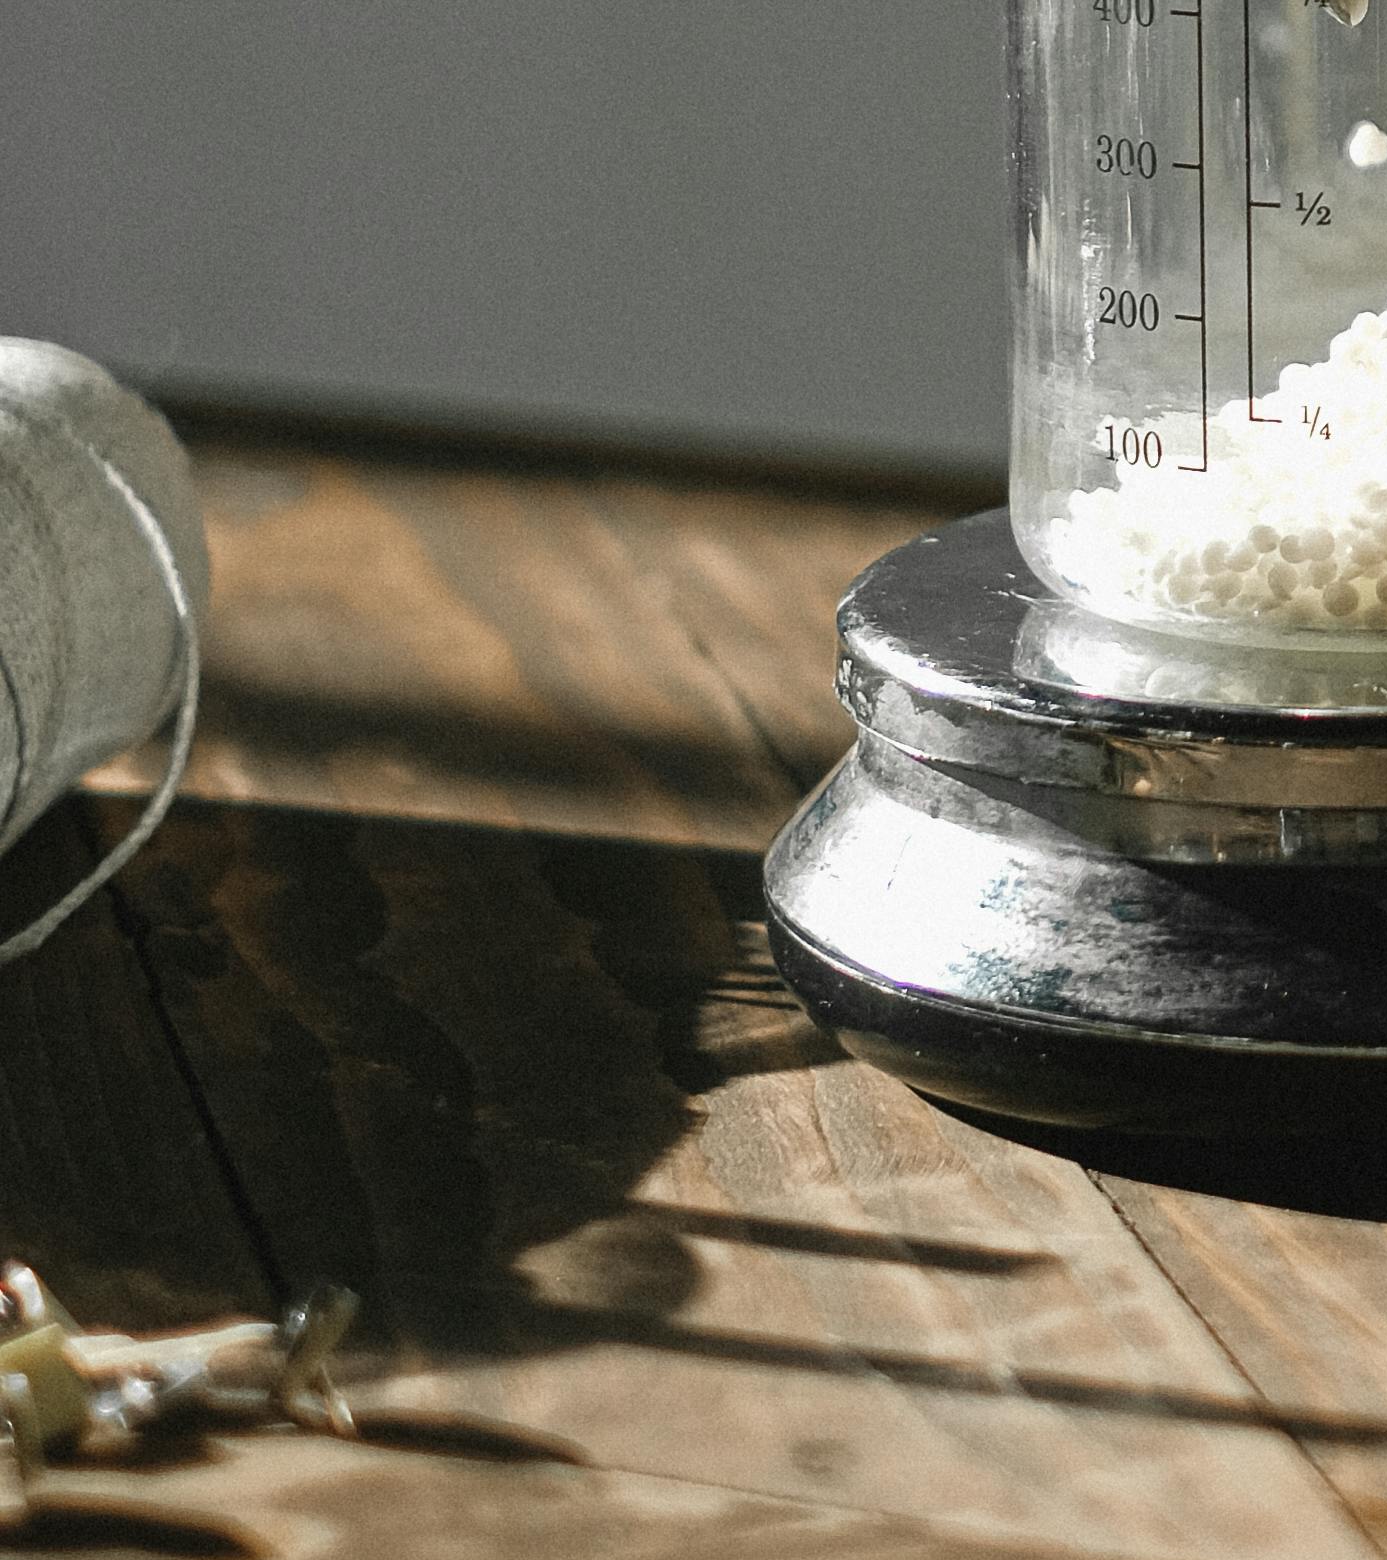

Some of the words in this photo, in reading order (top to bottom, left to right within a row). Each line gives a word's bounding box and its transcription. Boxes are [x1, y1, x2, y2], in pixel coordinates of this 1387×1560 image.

[1096, 136, 1159, 179] 300
[1294, 191, 1333, 227] 1/2
[1099, 287, 1161, 332] 200
[1103, 424, 1164, 470] 100
